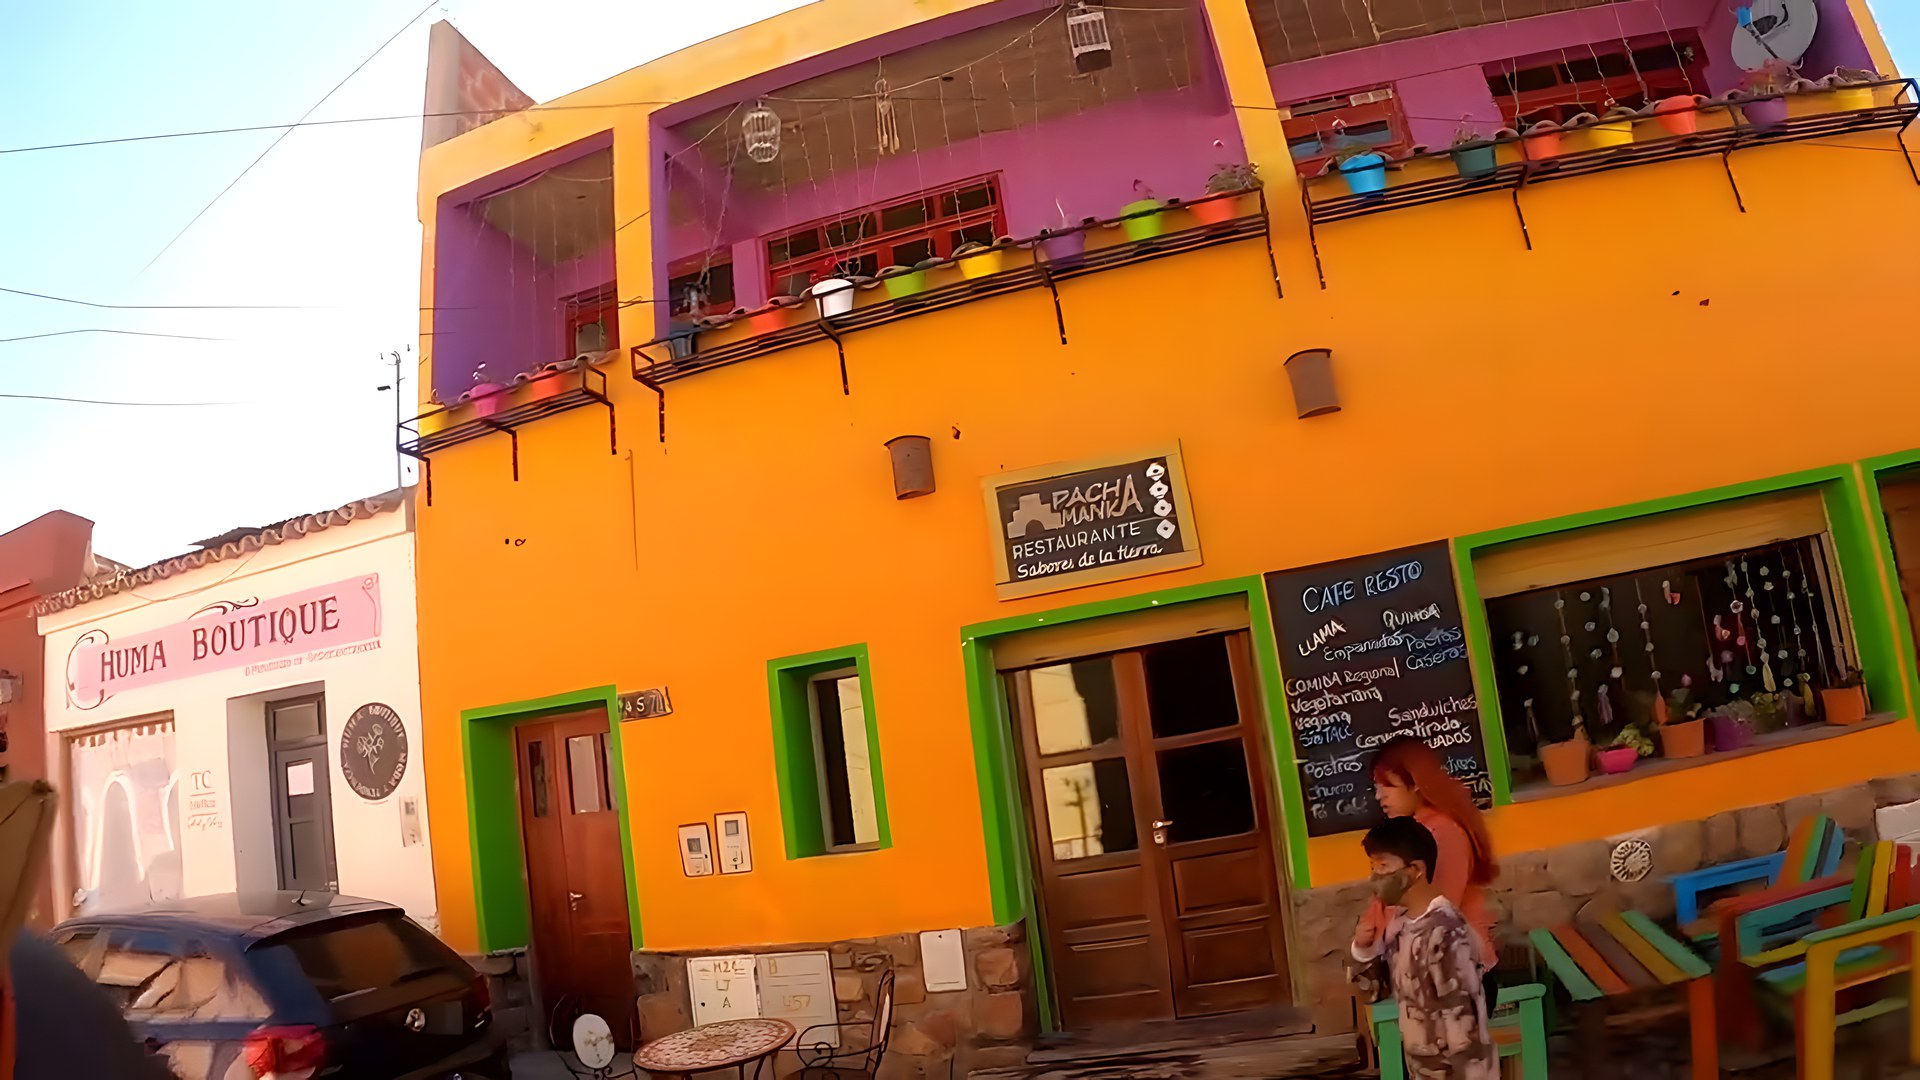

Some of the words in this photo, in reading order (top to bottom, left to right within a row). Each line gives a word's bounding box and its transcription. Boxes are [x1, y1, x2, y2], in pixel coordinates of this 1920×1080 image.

[1052, 474, 1142, 512] PACHA
[1012, 521, 1142, 560] RESTAURANTE
[1017, 558, 1074, 579] Sabores
[1078, 552, 1095, 567] de
[1099, 549, 1116, 563] la
[1117, 543, 1163, 560] tierra
[1302, 580, 1356, 613] CAFE
[1364, 560, 1423, 597] RESTO
[100, 639, 167, 682] HUMA
[192, 595, 341, 661] BOUTIQUE
[1298, 619, 1347, 657] LLAMA
[1405, 626, 1462, 652] Pastas
[1285, 672, 1342, 697] COMIDA
[1344, 657, 1400, 686] Regional
[722, 996, 732, 1009] A
